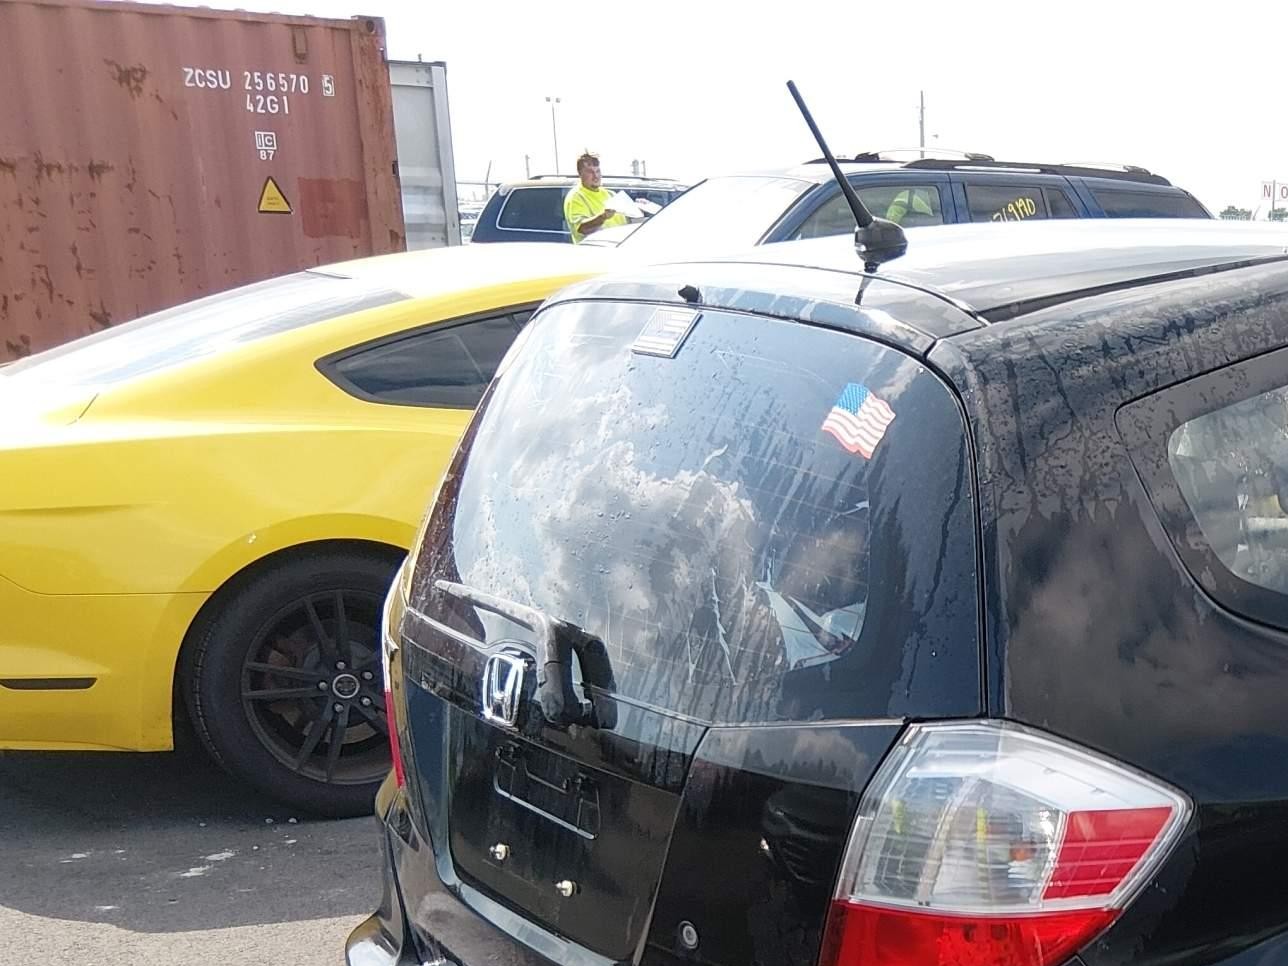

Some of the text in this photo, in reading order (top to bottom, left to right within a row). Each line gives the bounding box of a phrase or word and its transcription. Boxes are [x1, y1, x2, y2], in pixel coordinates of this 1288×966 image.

[183, 68, 334, 96] ZCSU 256570 5
[246, 95, 289, 114] 42G1
[260, 150, 275, 160] 87
